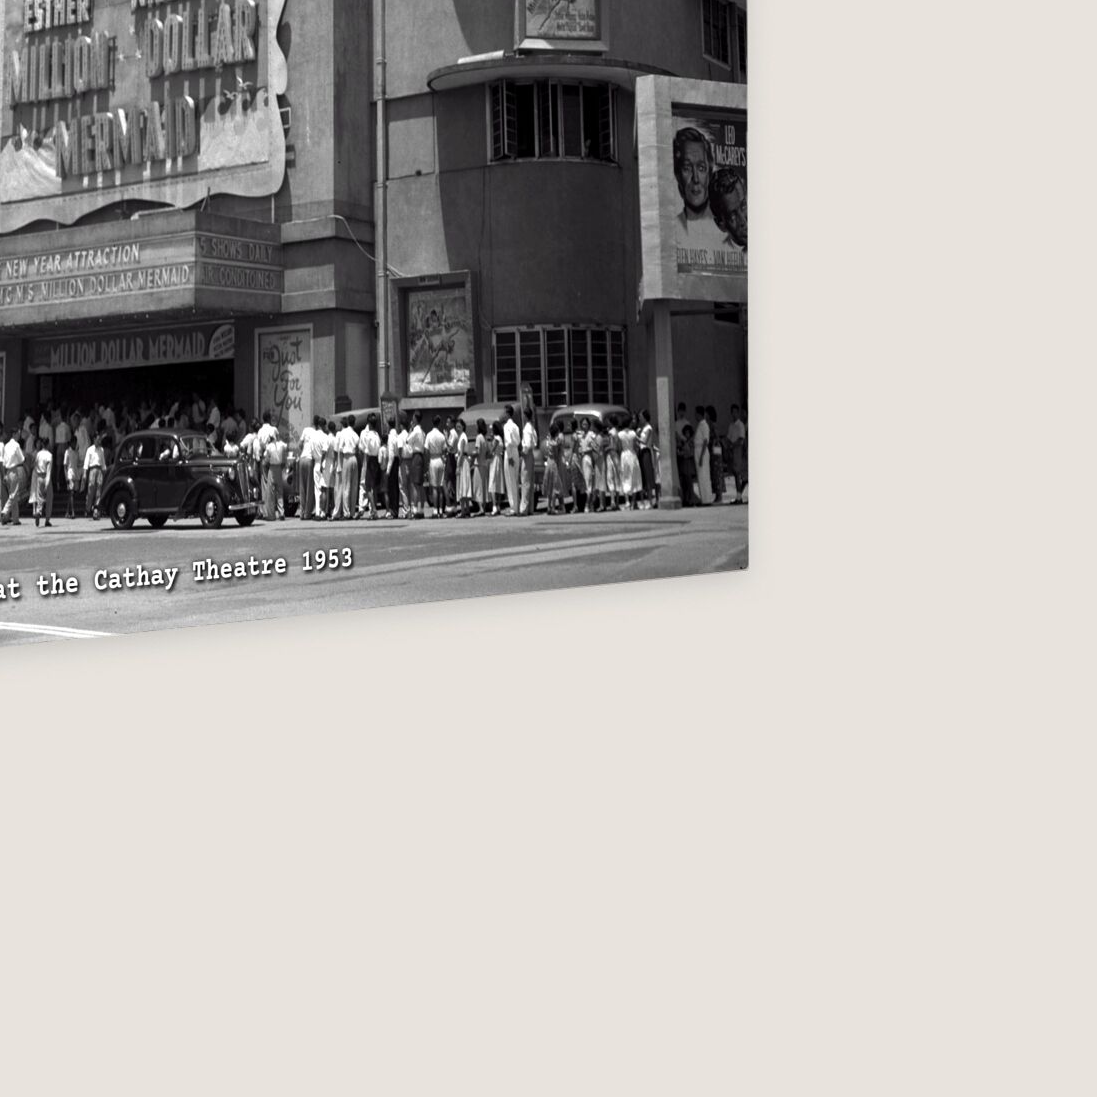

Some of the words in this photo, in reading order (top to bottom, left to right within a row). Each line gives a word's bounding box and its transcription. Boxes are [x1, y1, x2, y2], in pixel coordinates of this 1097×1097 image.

[145, 2, 257, 78] DOLLAR
[56, 96, 197, 178] MERMAID
[6, 258, 28, 278] NEW
[34, 254, 61, 274] YEAR
[66, 243, 140, 268] ATTRACTION
[212, 237, 243, 259] SHOWS
[248, 243, 273, 264] DAILY
[41, 278, 84, 299] MILLION
[90, 272, 133, 294] DOLLAR
[138, 265, 189, 287] MERMAID
[51, 340, 96, 367] MILLION
[100, 336, 144, 363] DOLLAR
[149, 330, 205, 360] MERMAID
[269, 336, 303, 382] Just
[280, 370, 302, 391] For
[273, 384, 303, 428] You
